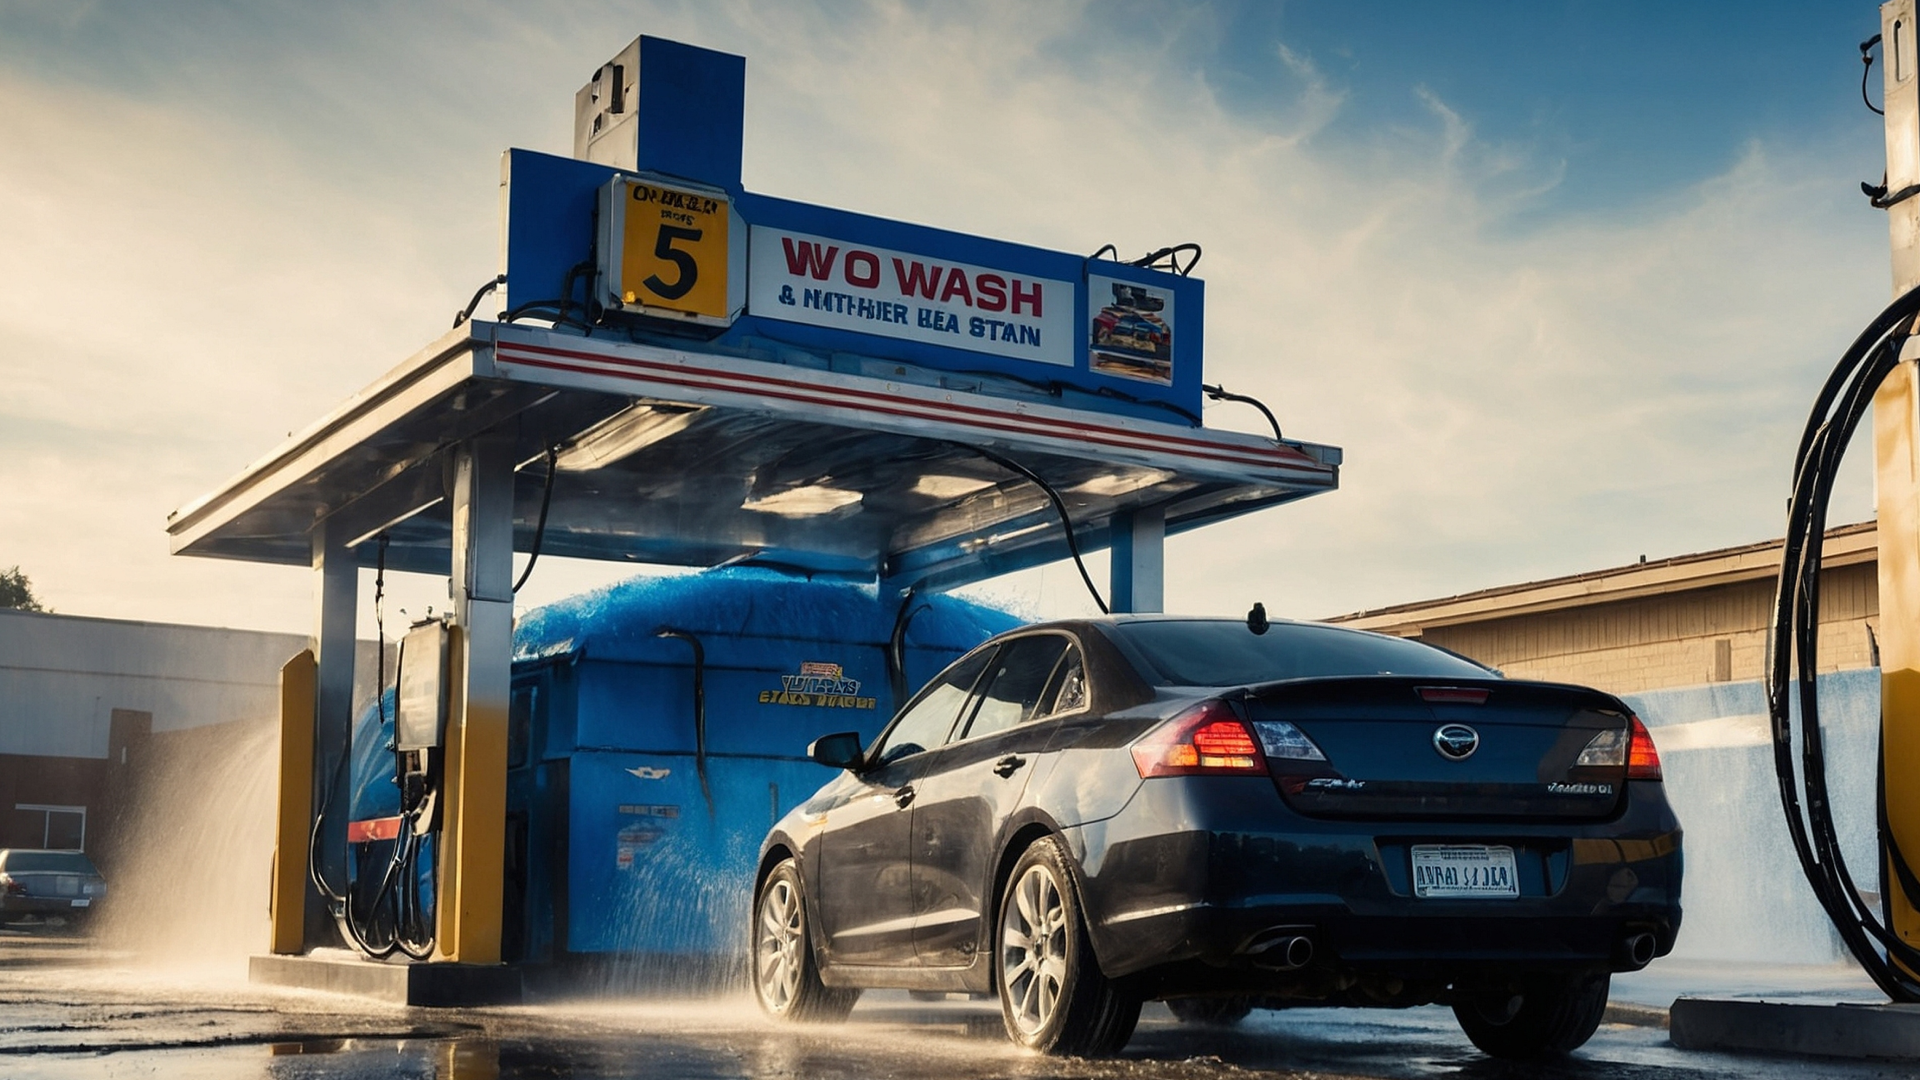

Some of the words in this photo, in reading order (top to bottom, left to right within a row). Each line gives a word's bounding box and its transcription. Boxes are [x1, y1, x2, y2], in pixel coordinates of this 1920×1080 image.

[643, 224, 702, 300] 5
[782, 237, 880, 289] WO
[892, 257, 1042, 317] WASH
